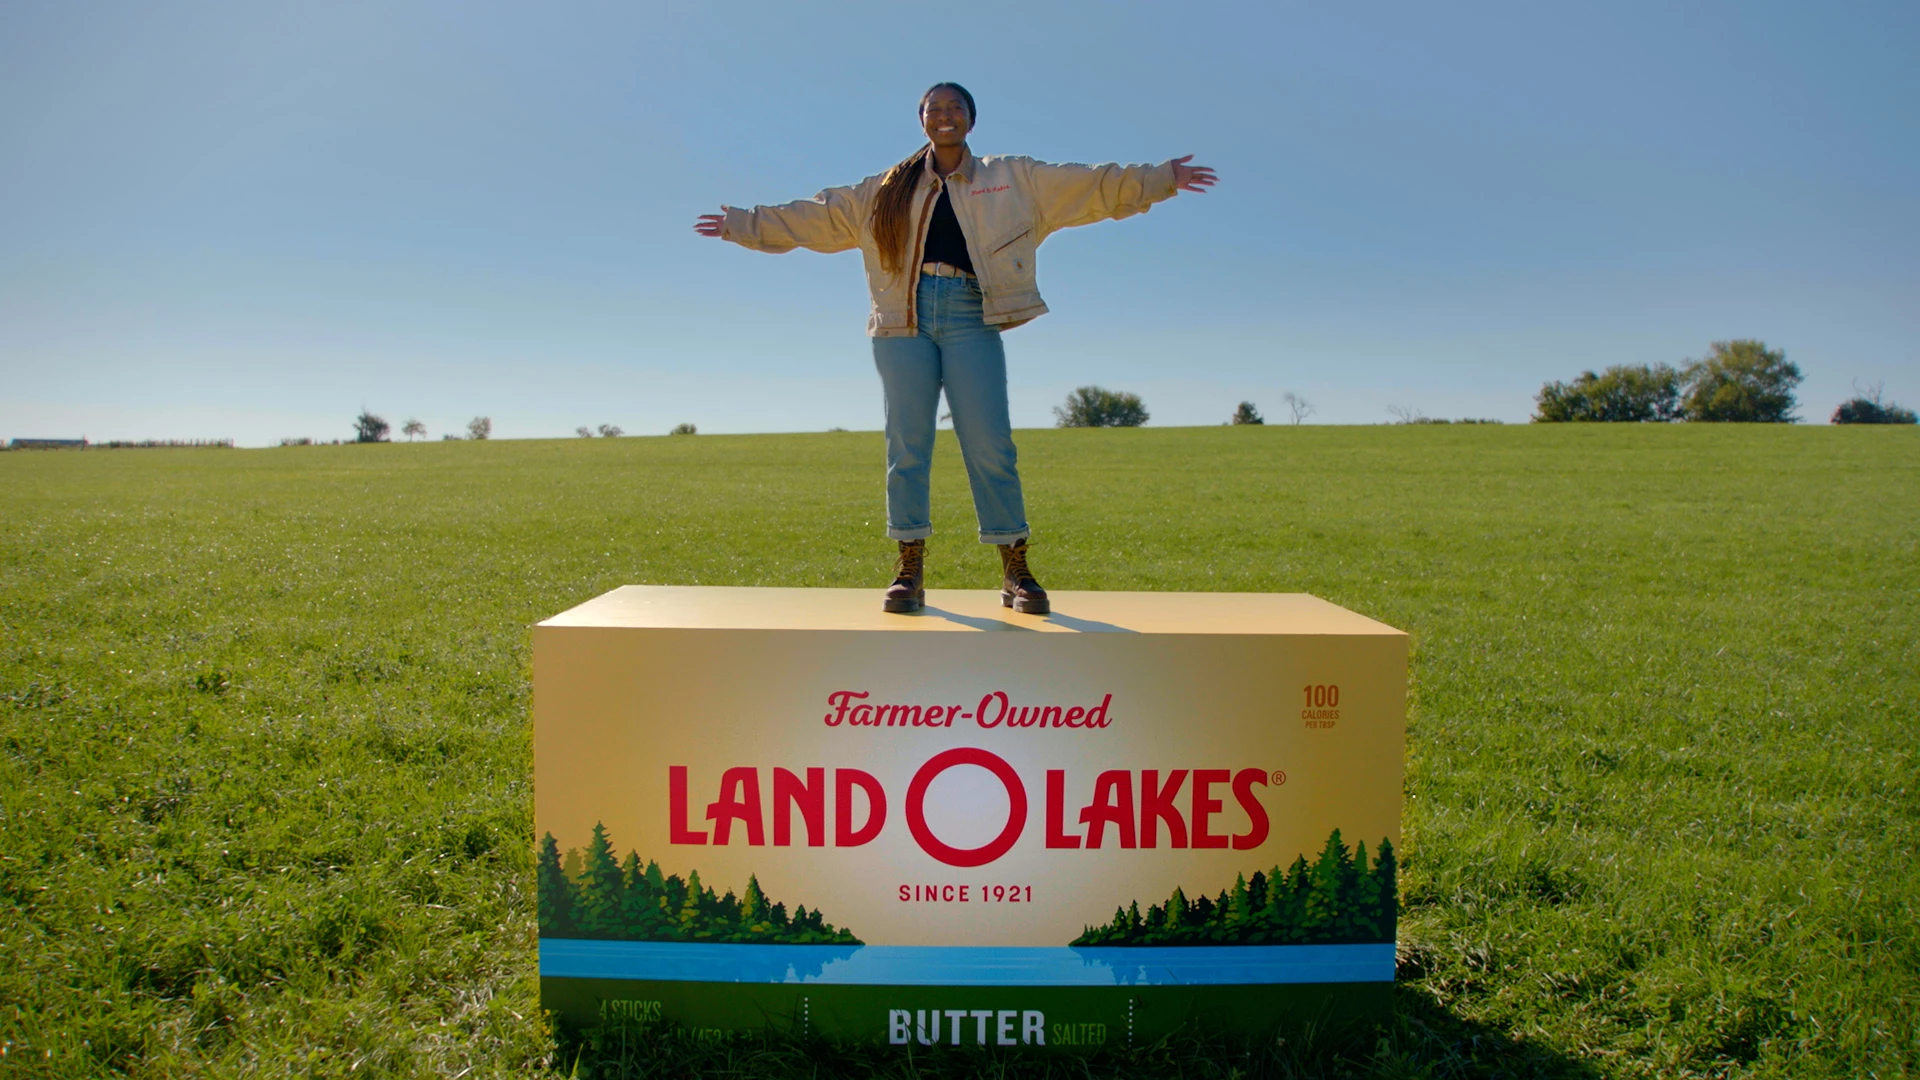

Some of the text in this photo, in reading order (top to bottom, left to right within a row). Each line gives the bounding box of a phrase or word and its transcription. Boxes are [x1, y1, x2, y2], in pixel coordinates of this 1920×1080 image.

[1303, 684, 1339, 708] 100
[824, 690, 1113, 729] Farmer-Owned
[1301, 709, 1339, 720] CALORIES
[1305, 720, 1335, 729] PER TBSP
[669, 765, 887, 848] LAND
[904, 747, 1028, 868] O
[899, 884, 1033, 904] SINCE 1921
[600, 999, 662, 1022] 4 STICKS
[889, 1009, 1106, 1047] BUTTER SALTED
